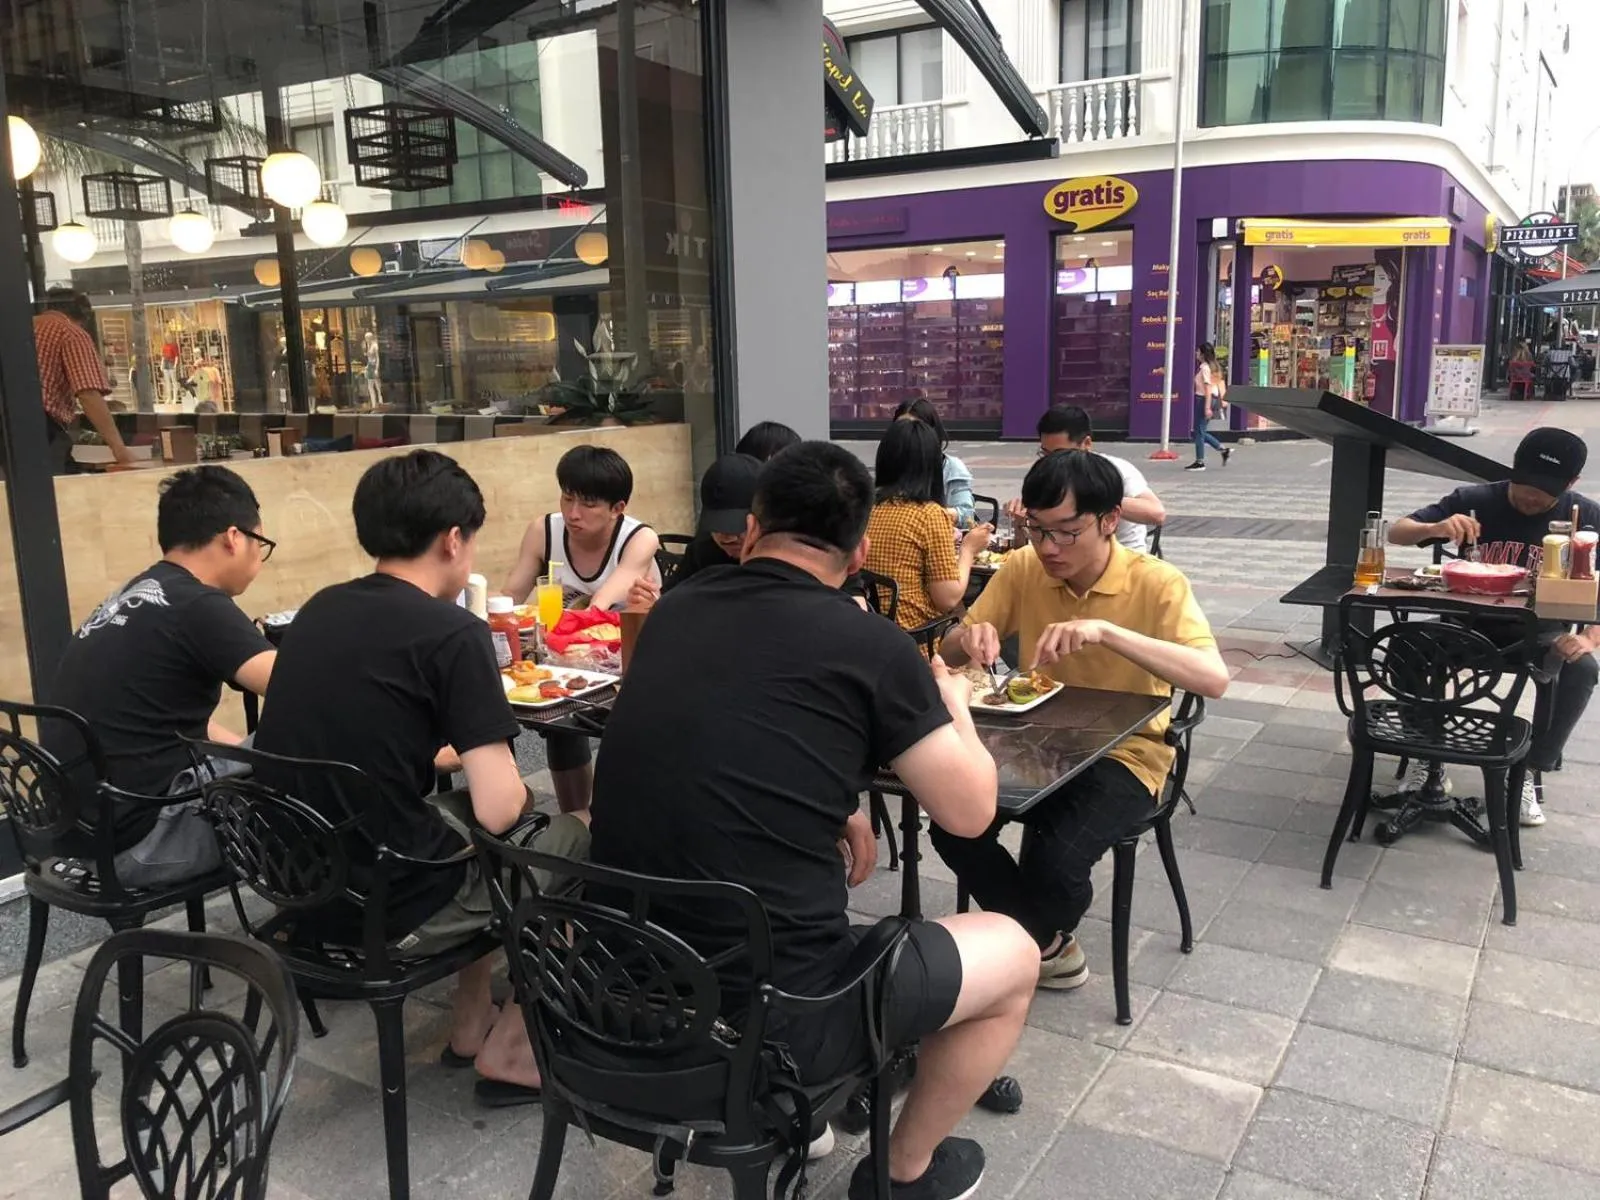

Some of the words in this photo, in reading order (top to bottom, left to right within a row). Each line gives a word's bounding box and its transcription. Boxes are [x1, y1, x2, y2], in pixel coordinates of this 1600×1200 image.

[1053, 180, 1125, 214] gratis
[1265, 230, 1294, 241] gratis
[1402, 230, 1431, 241] gratis
[1506, 230, 1537, 240] PIZZA
[1543, 228, 1574, 238] JOB'S
[1563, 290, 1599, 302] PIZZA
